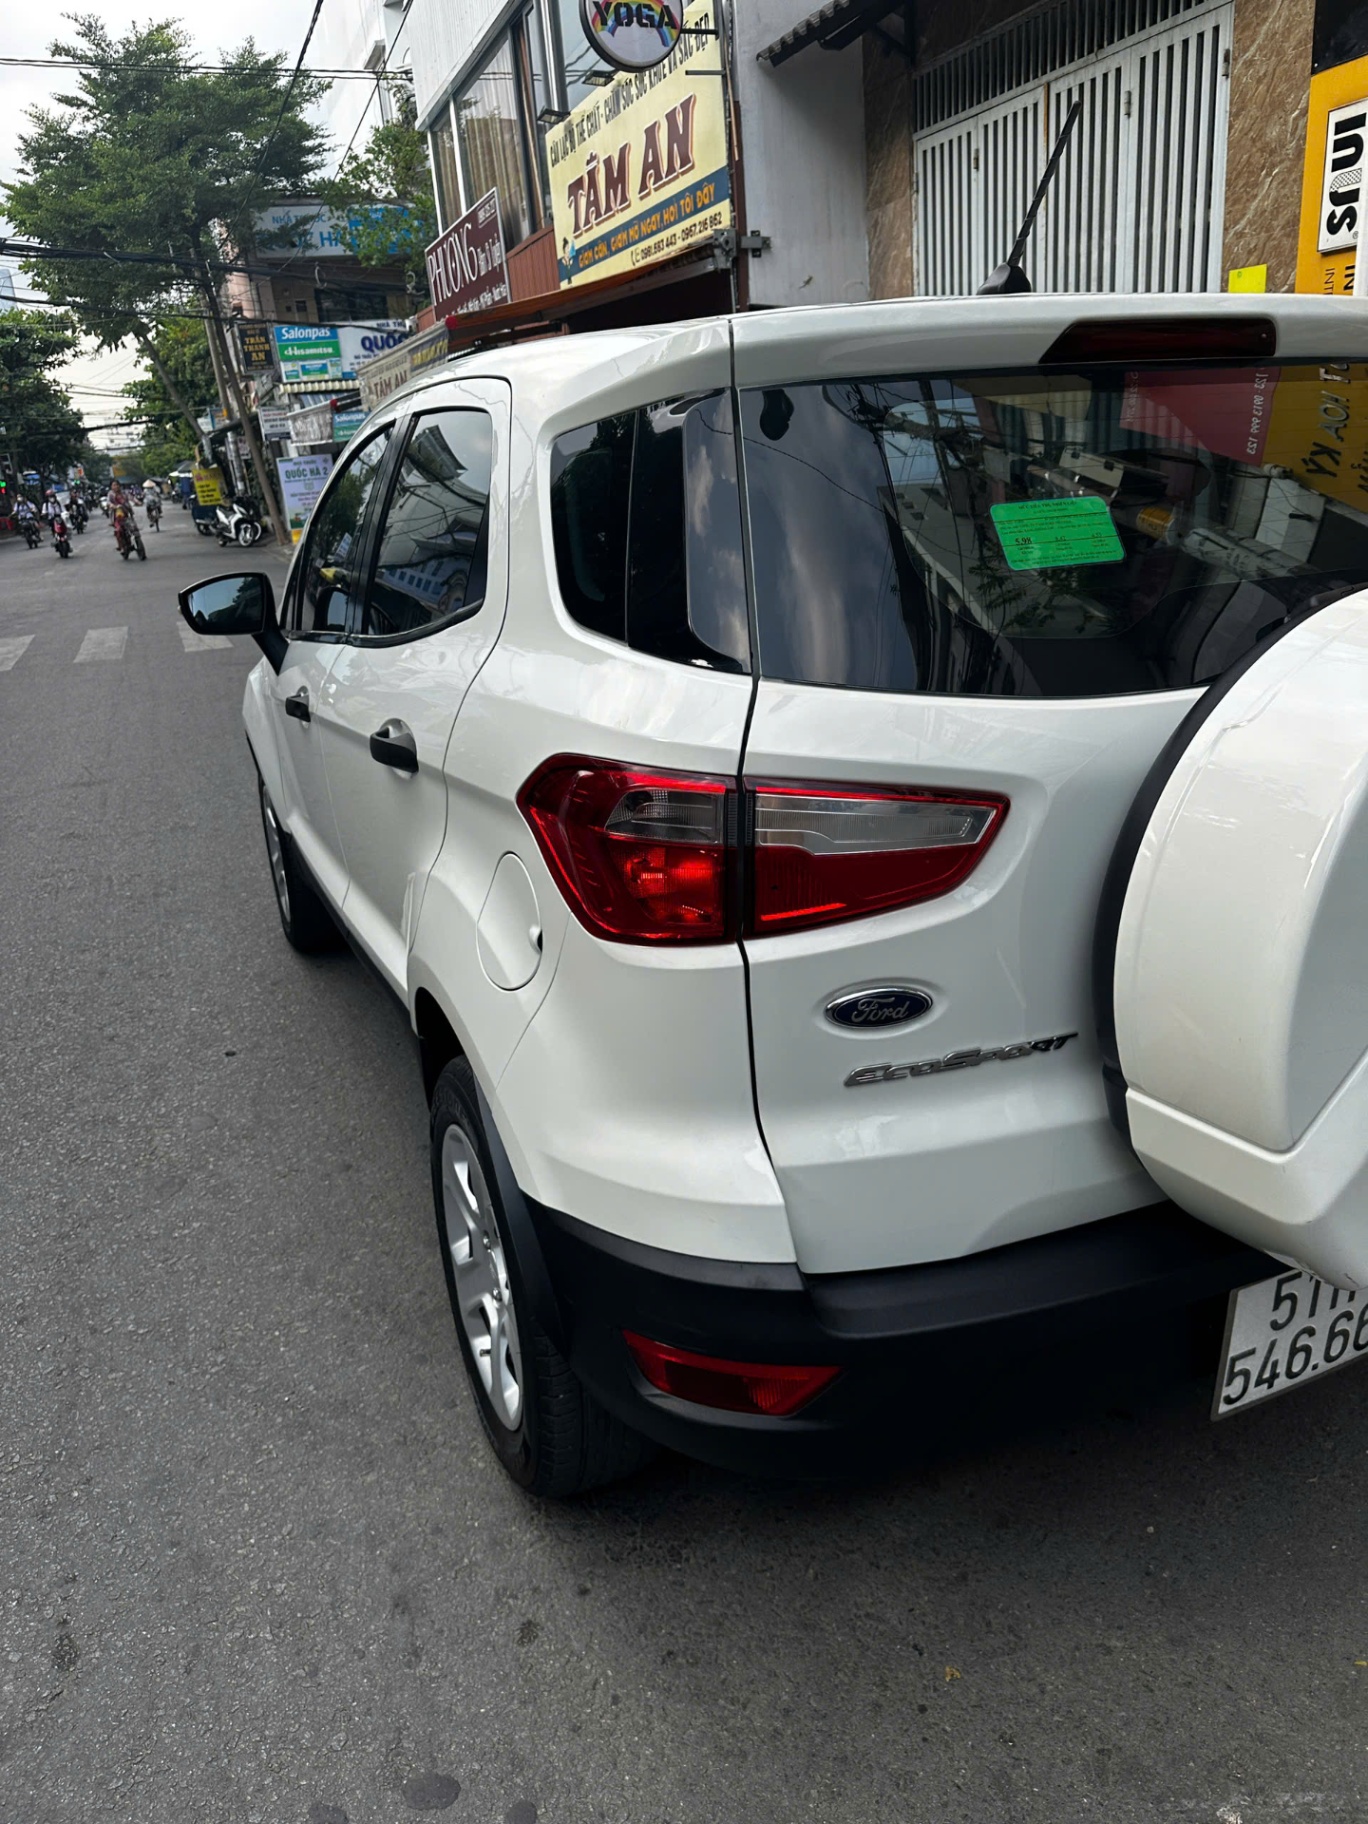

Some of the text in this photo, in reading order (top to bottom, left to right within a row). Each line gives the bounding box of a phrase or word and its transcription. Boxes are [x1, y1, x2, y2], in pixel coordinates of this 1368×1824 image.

[592, 0, 678, 29] YOGA
[638, 93, 697, 200] AN
[1324, 268, 1335, 295] INT
[282, 326, 330, 340] Salonpas
[851, 997, 909, 1023] Ford
[843, 1031, 1079, 1087] EcoSport
